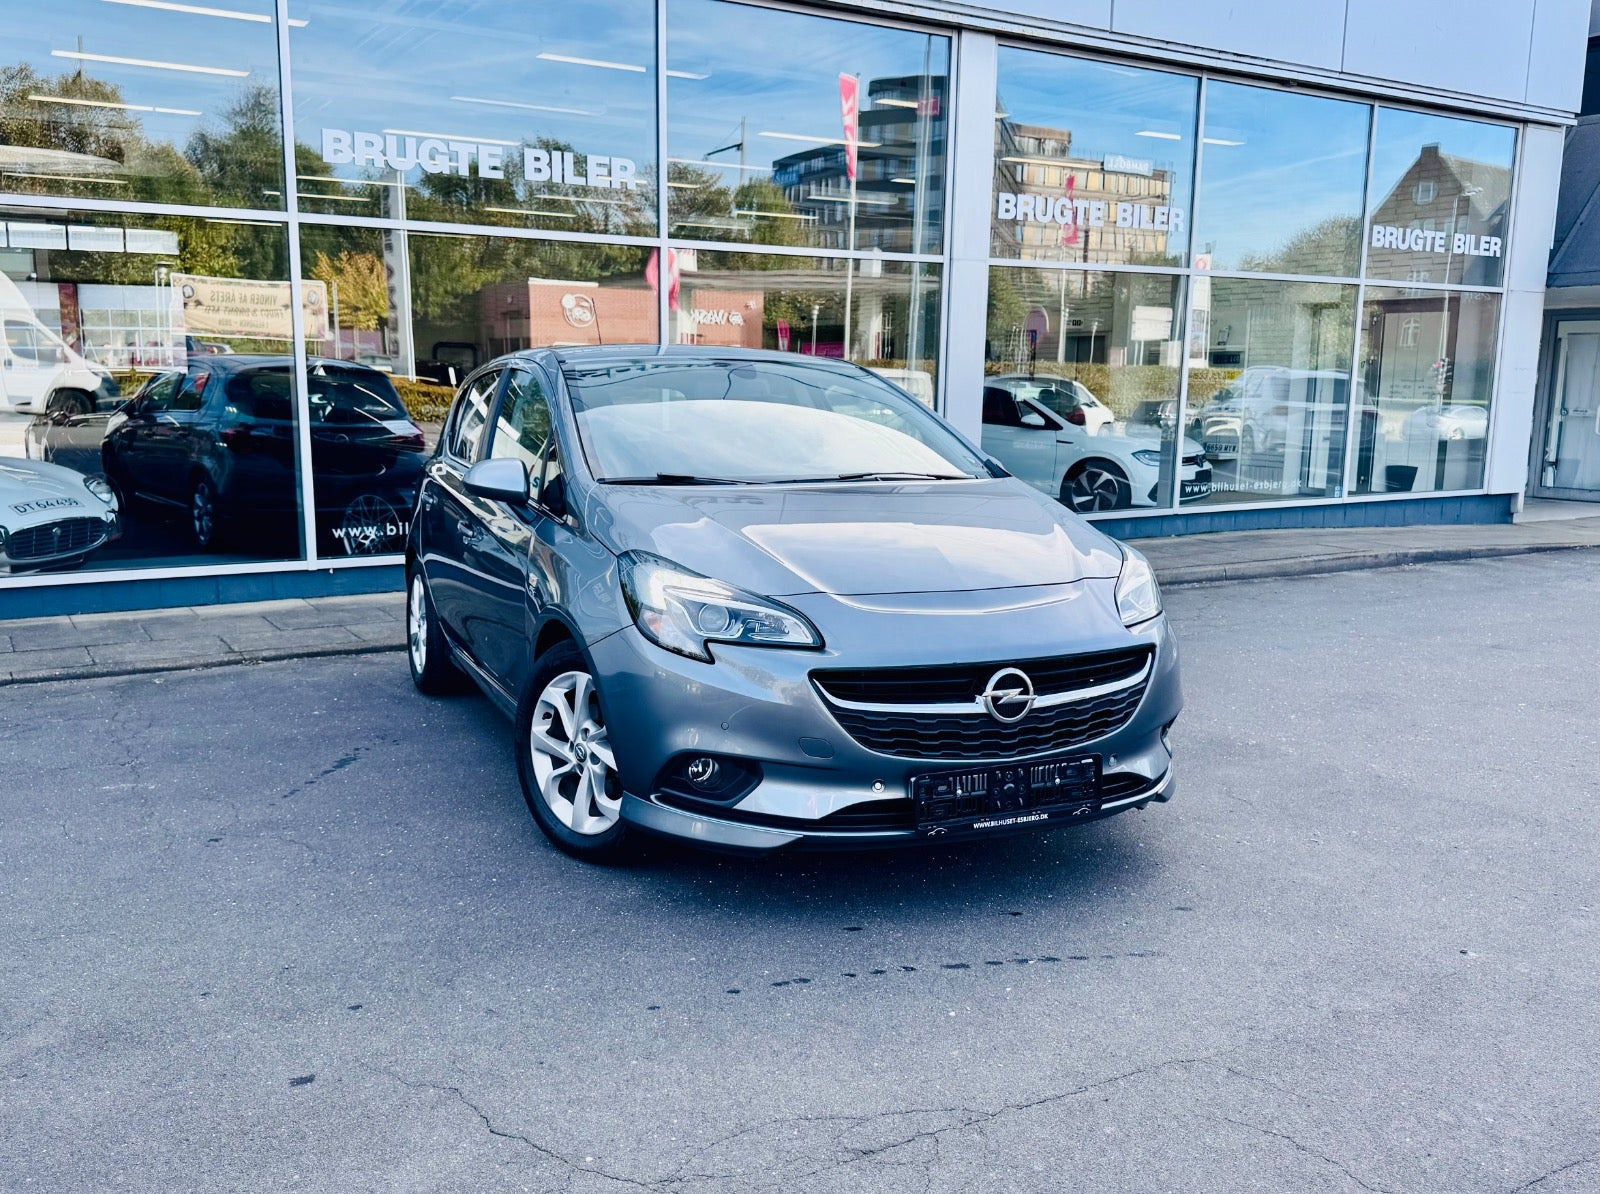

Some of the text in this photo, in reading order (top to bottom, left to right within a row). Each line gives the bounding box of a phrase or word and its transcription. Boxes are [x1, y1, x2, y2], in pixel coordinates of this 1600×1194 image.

[321, 128, 637, 190] BRUGTE BILER
[998, 192, 1184, 232] BRUGTE BILER
[1372, 224, 1502, 257] BRUGTE BILER
[14, 503, 34, 513] DT
[36, 500, 55, 509] 64
[973, 813, 1049, 829] WWW.BILHUSET-ESBJERG.DK
